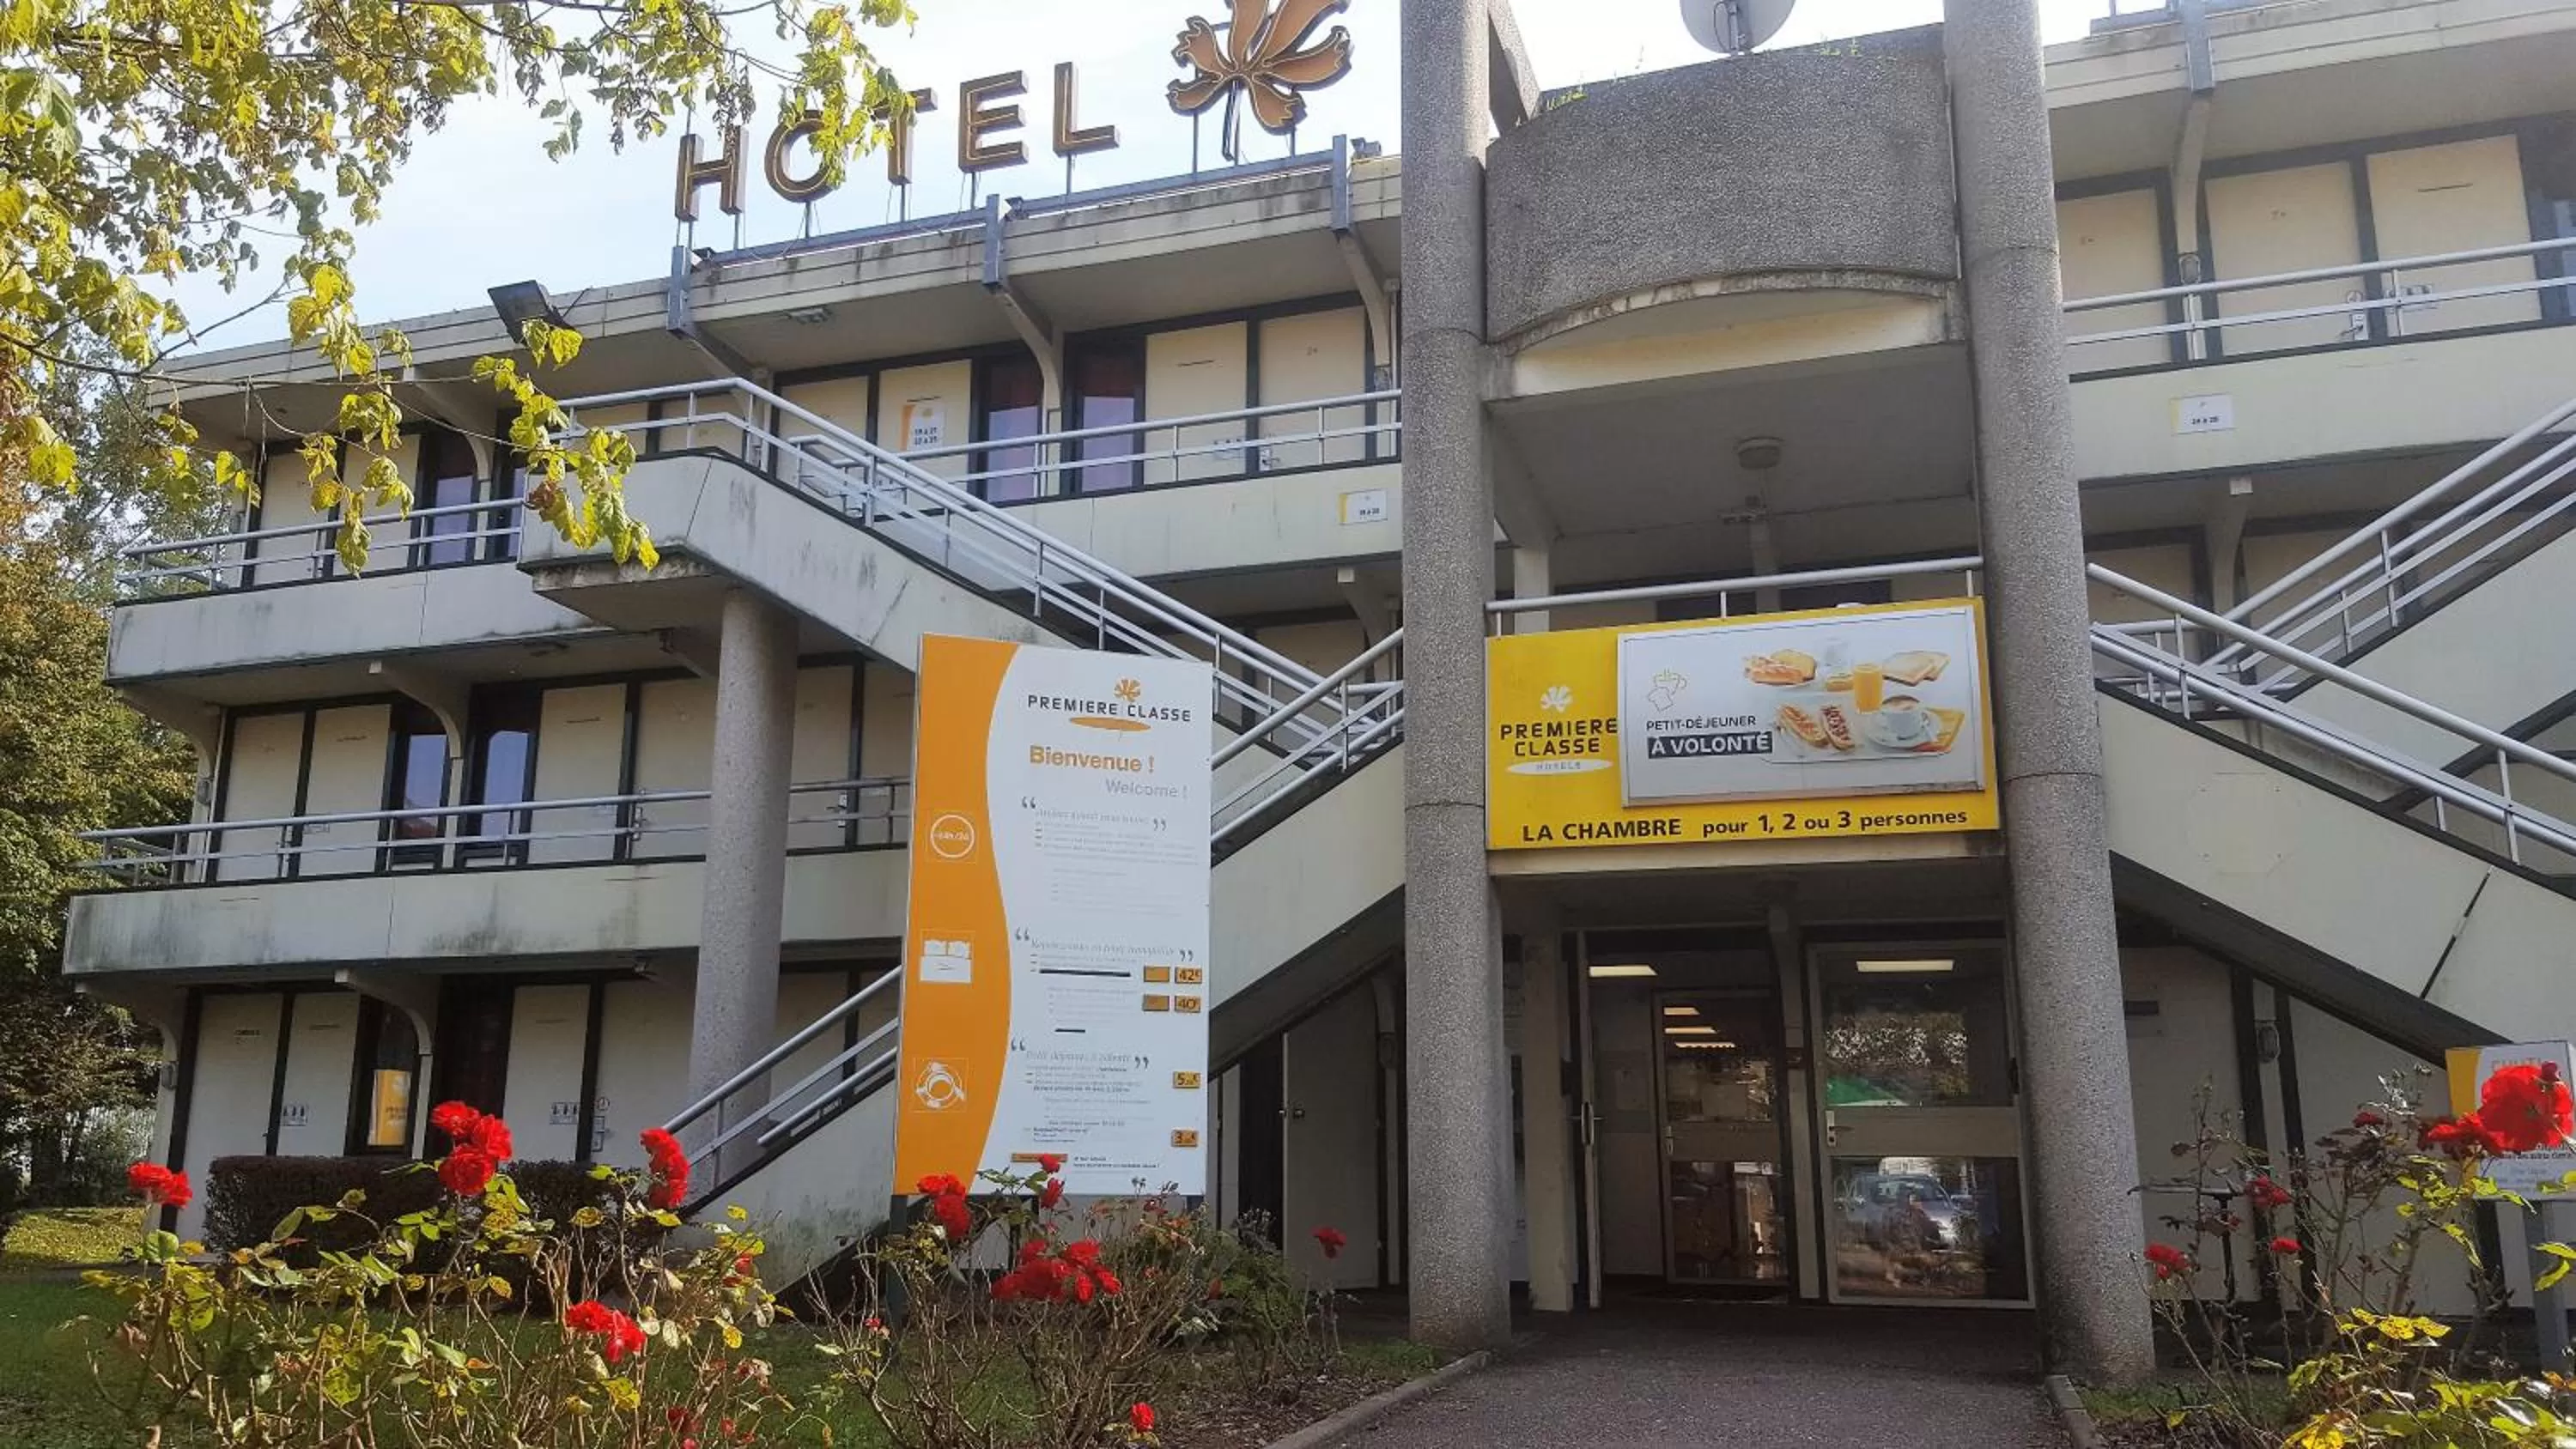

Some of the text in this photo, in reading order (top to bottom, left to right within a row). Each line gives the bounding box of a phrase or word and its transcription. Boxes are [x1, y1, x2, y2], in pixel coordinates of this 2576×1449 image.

[675, 61, 1121, 221] HOTEL
[1027, 694, 1192, 722] PREMIERE CLASSE
[1501, 718, 1618, 740] PREMIERE
[1646, 715, 1756, 731] PETIT-DÉJEUNER
[1514, 737, 1601, 756] CLASSE
[1671, 731, 1771, 754] VOLONTÉ
[1030, 744, 1142, 772] Bienvenue
[1105, 779, 1178, 797] Welcome
[1522, 824, 1553, 842] LA
[1562, 818, 1682, 840] CHAMBRE
[1702, 820, 1748, 839] pour
[1782, 814, 1797, 831] 2
[1804, 820, 1831, 831] ou
[1837, 811, 1852, 828] 3
[1860, 810, 1968, 831] personnes
